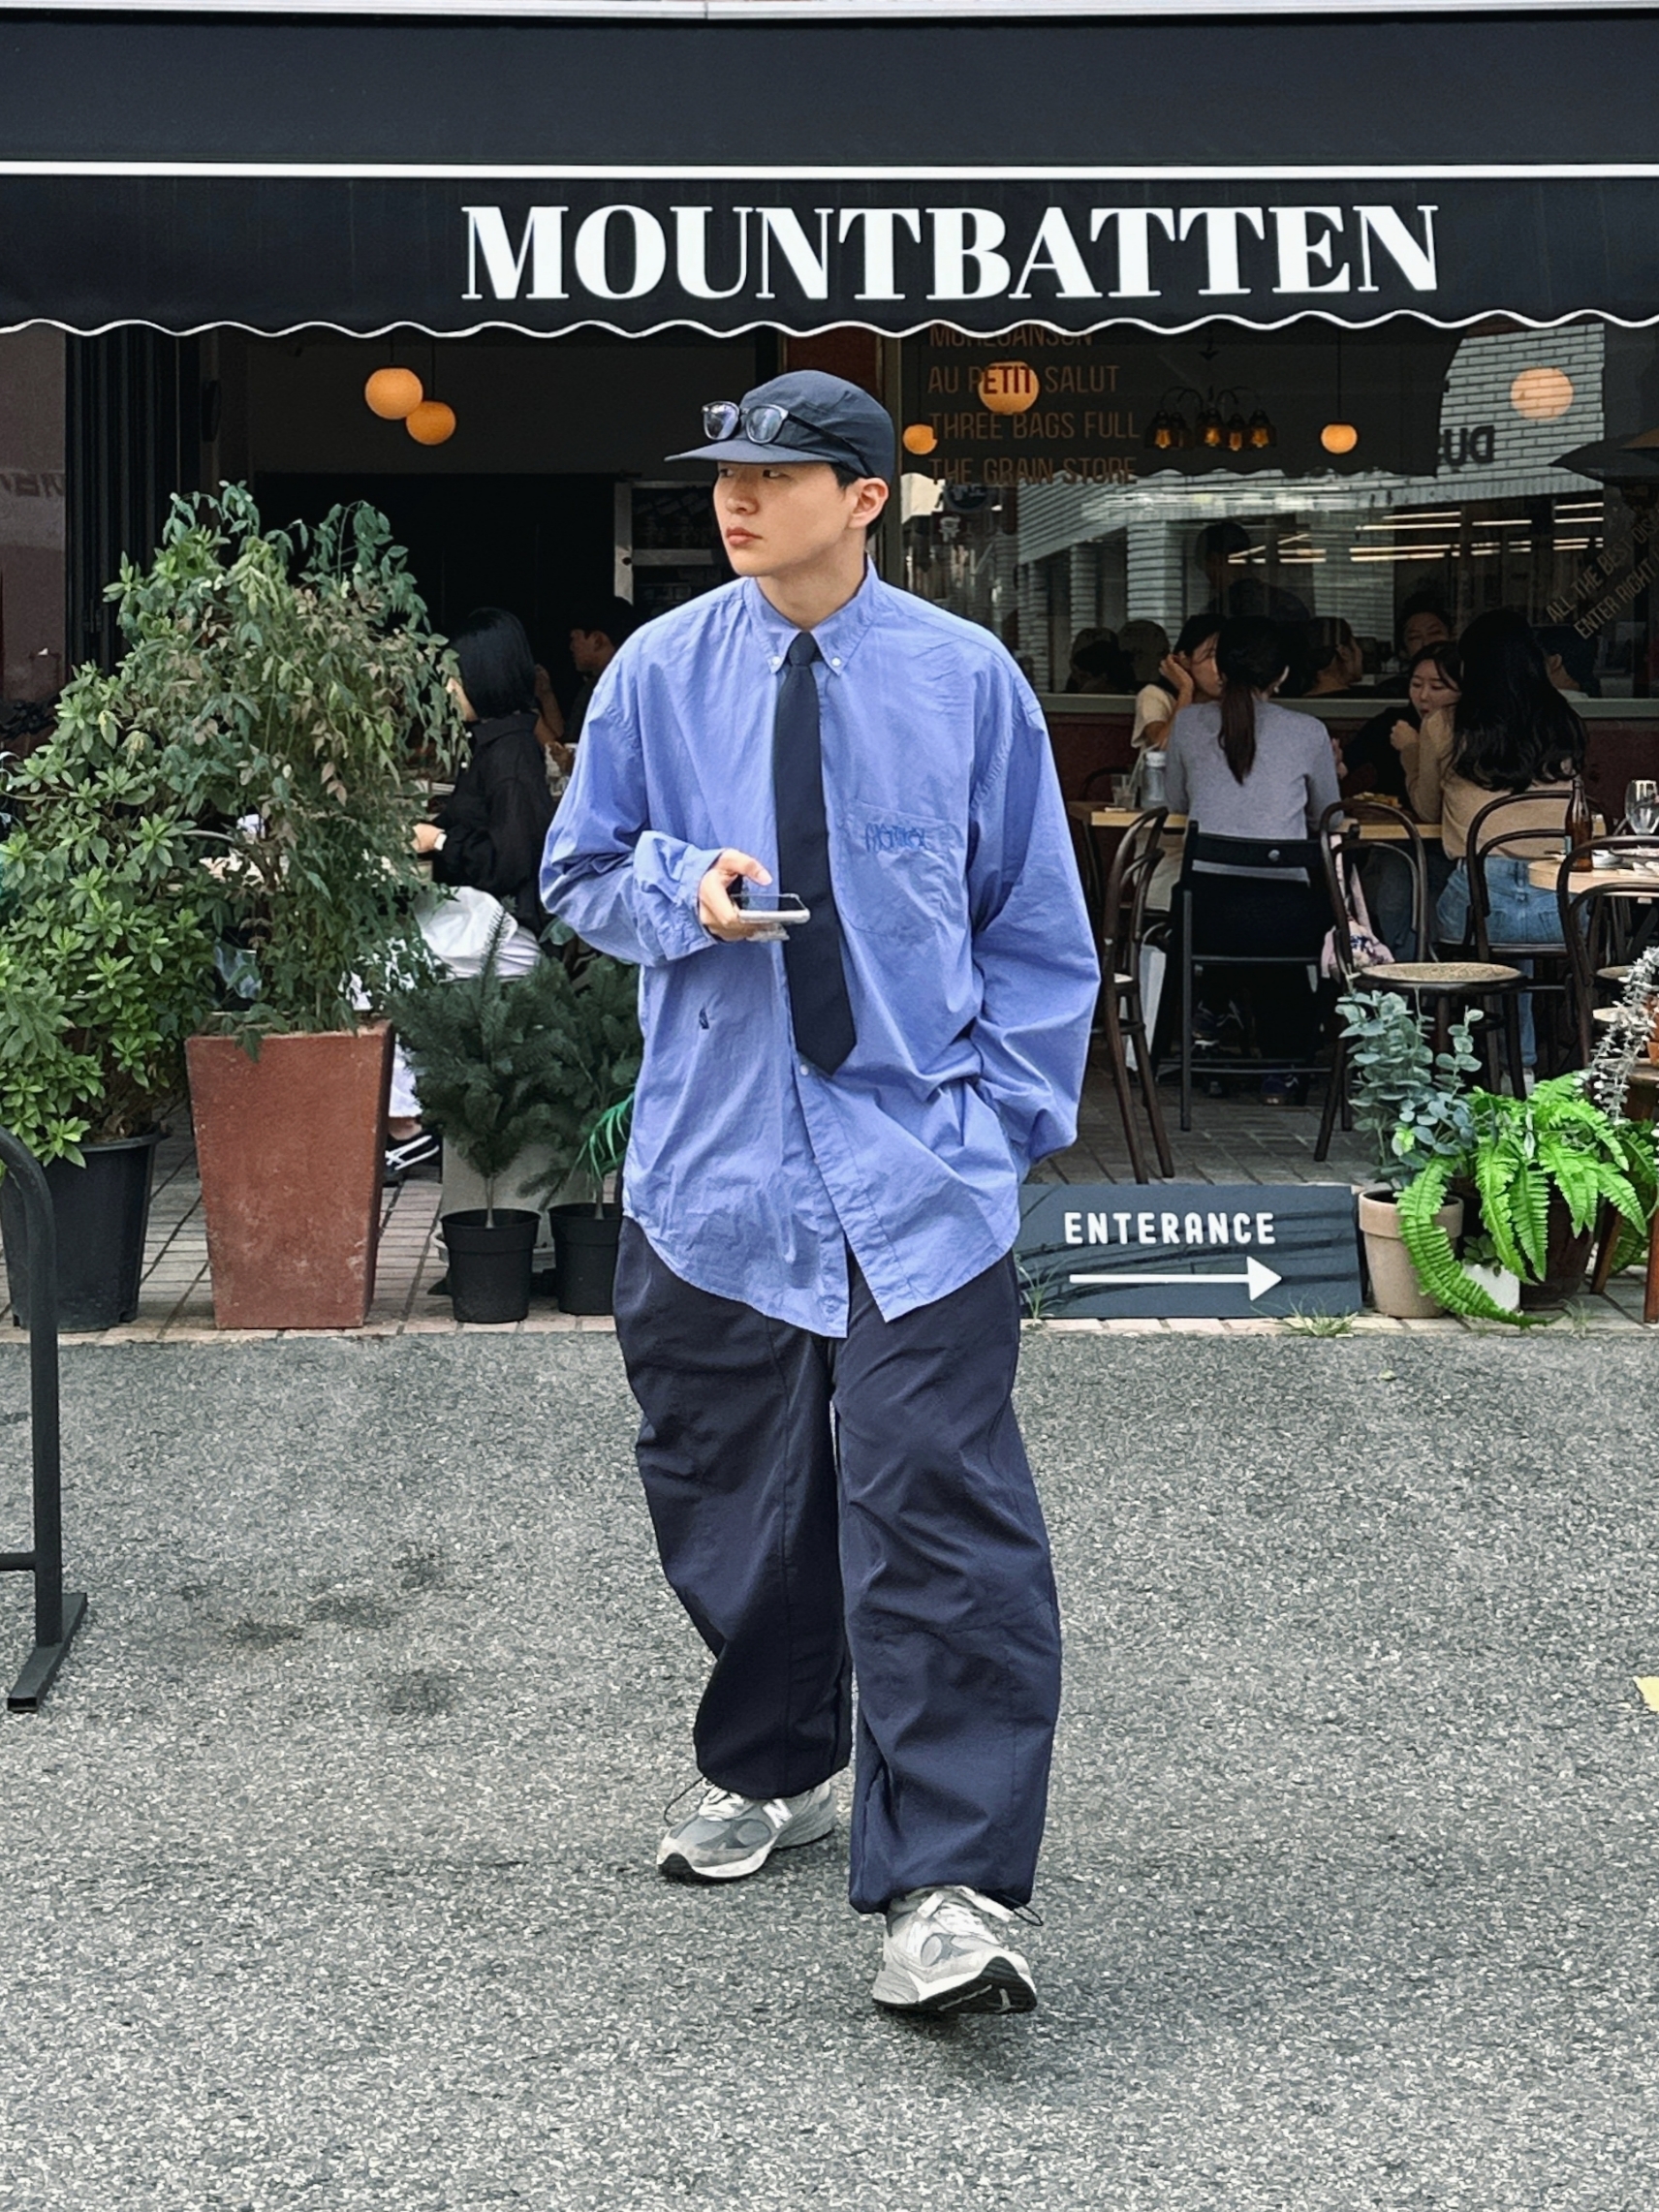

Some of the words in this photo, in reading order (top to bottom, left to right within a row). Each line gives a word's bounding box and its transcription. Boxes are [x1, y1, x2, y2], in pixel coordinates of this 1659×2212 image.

[462, 205, 1438, 299] MOUNTBATTEN
[927, 365, 959, 394] AU
[968, 365, 1032, 394] PETIT
[1044, 364, 1120, 394] SALUT
[929, 412, 1003, 440] THREE
[1012, 412, 1076, 440] BAGS
[1083, 411, 1141, 440] FULL
[928, 457, 974, 485] THE
[983, 457, 1053, 485] GRAIN
[1062, 457, 1138, 485] STORE
[1546, 596, 1577, 624] ALL
[1571, 565, 1604, 600] THE
[1596, 538, 1633, 576] BEST
[1573, 595, 1621, 640] ENTER
[1614, 557, 1656, 604] RIGHT
[1065, 1212, 1275, 1244] ENTERANCE
[763, 1798, 794, 1829] N
